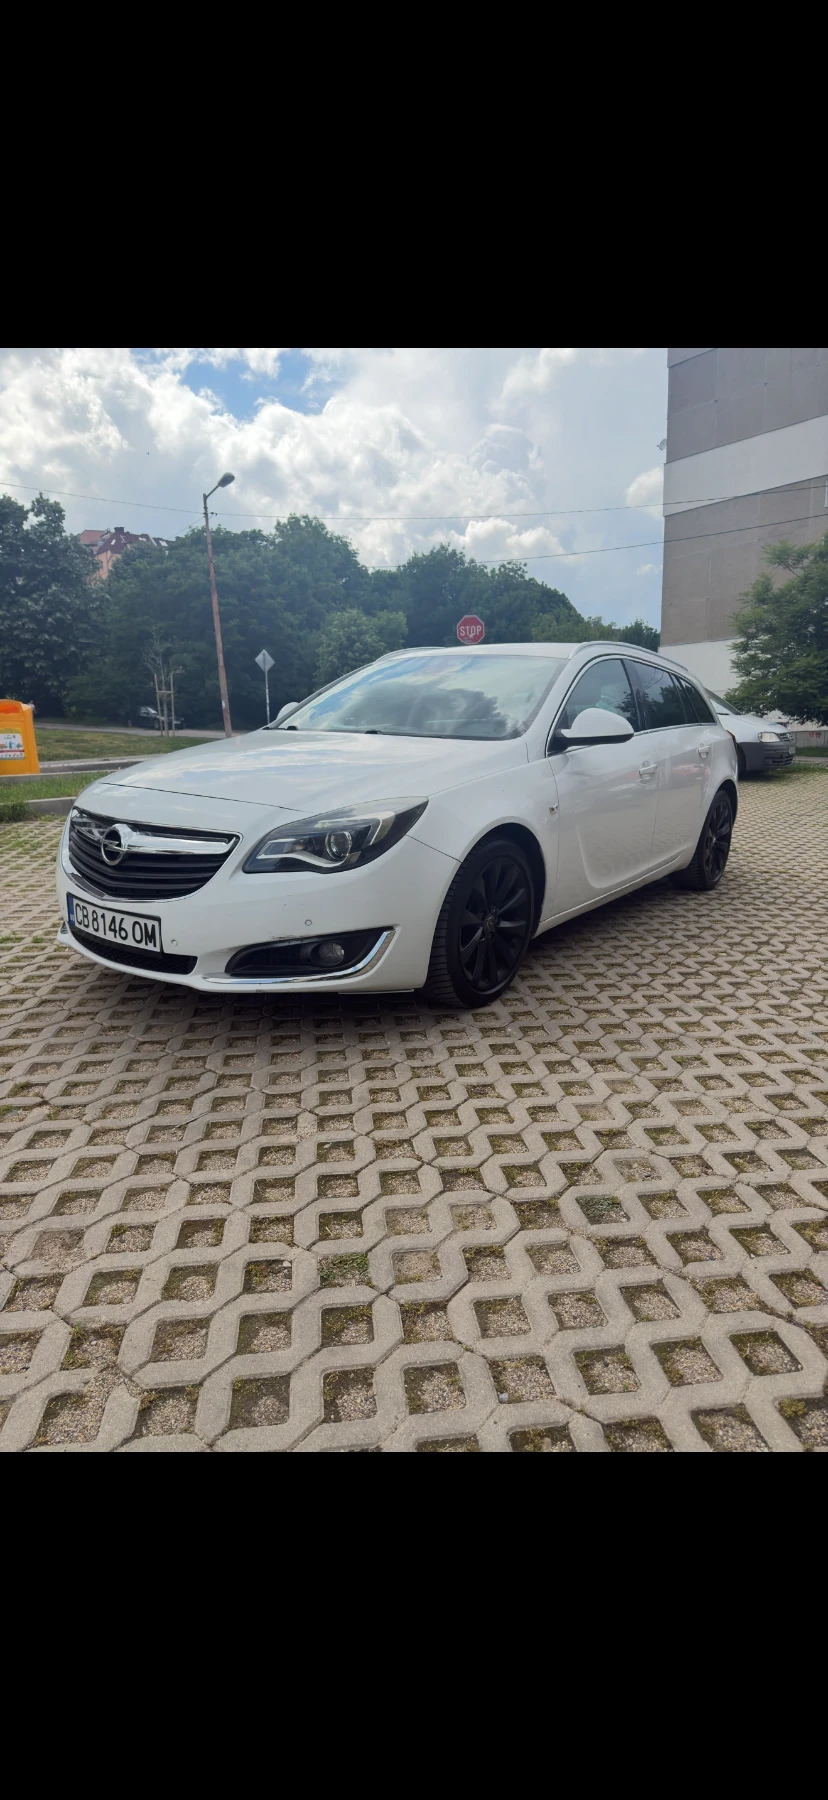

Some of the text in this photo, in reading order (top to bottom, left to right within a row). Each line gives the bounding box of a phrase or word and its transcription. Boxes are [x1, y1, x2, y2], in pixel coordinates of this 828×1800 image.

[459, 625, 482, 637] STOP
[75, 902, 157, 948] CB 8146 OM
